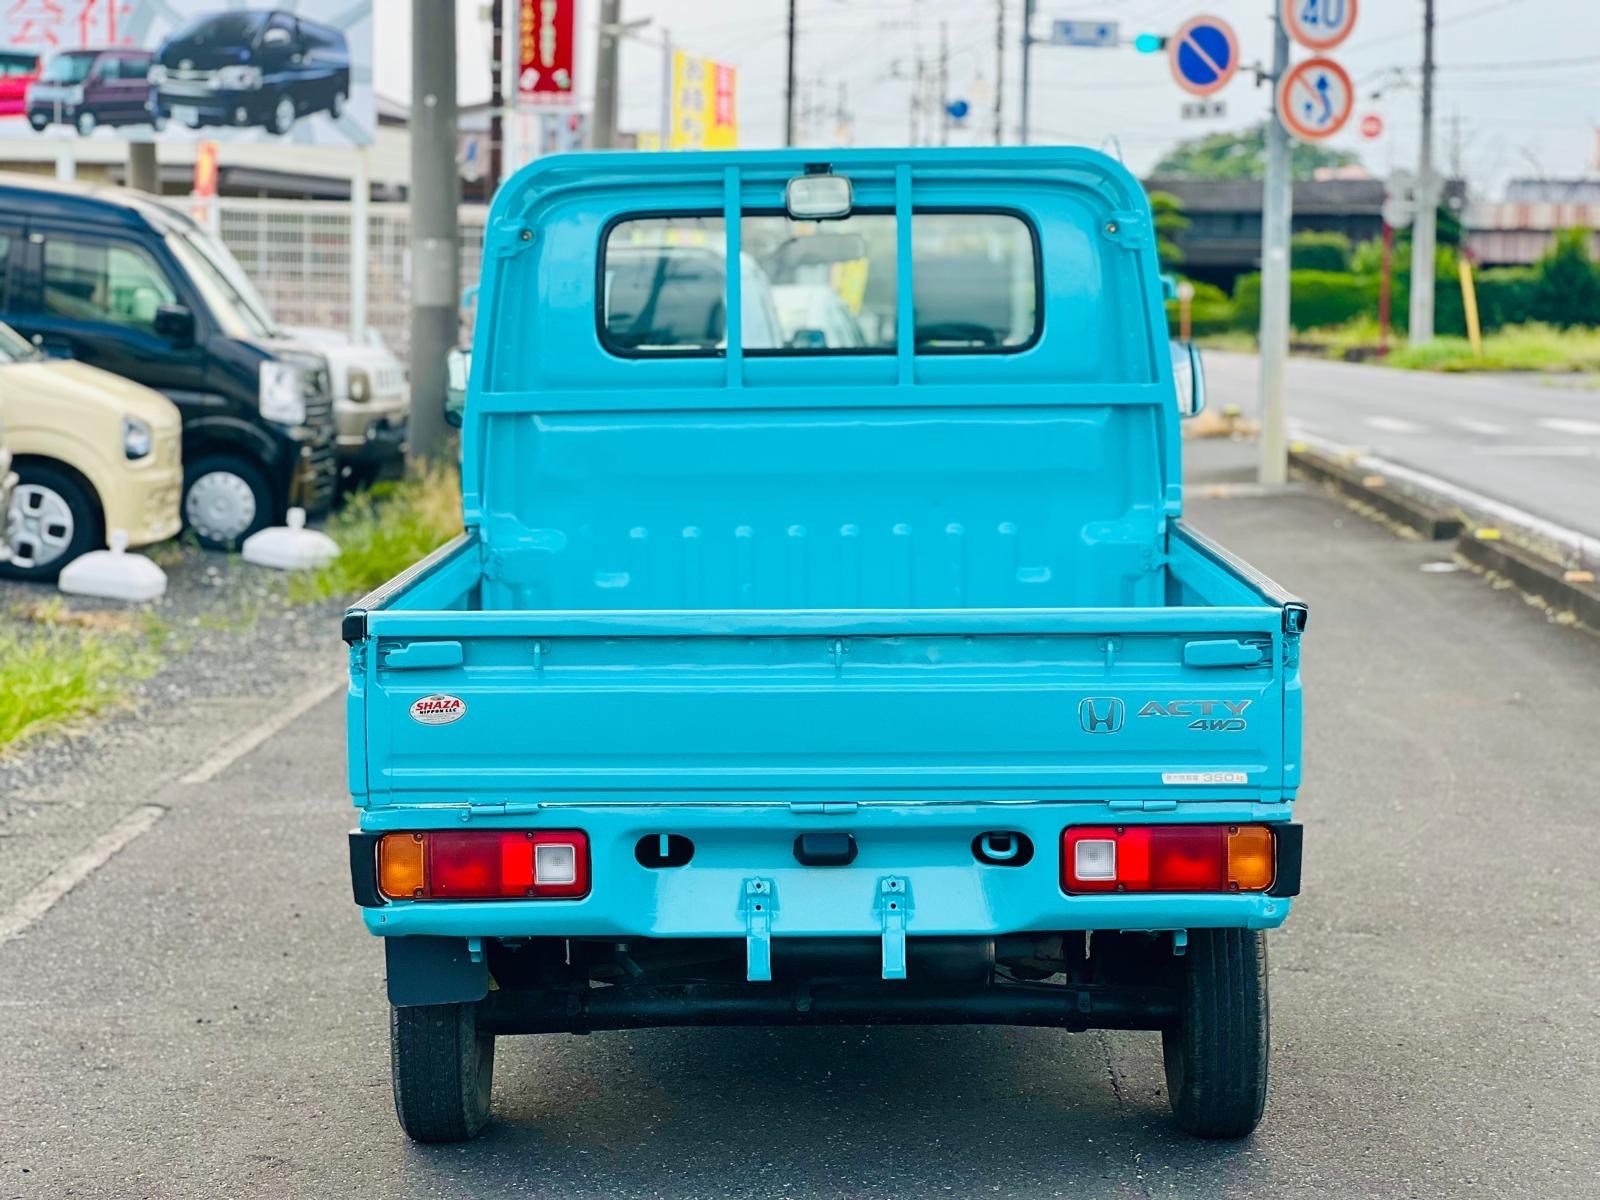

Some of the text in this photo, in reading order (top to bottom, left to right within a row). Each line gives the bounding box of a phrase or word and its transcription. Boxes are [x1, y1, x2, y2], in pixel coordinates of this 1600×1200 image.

[416, 700, 460, 711] SHAZA
[1137, 699, 1253, 718] ACTY
[1188, 718, 1248, 732] 4WD
[1202, 773, 1234, 782] 350
